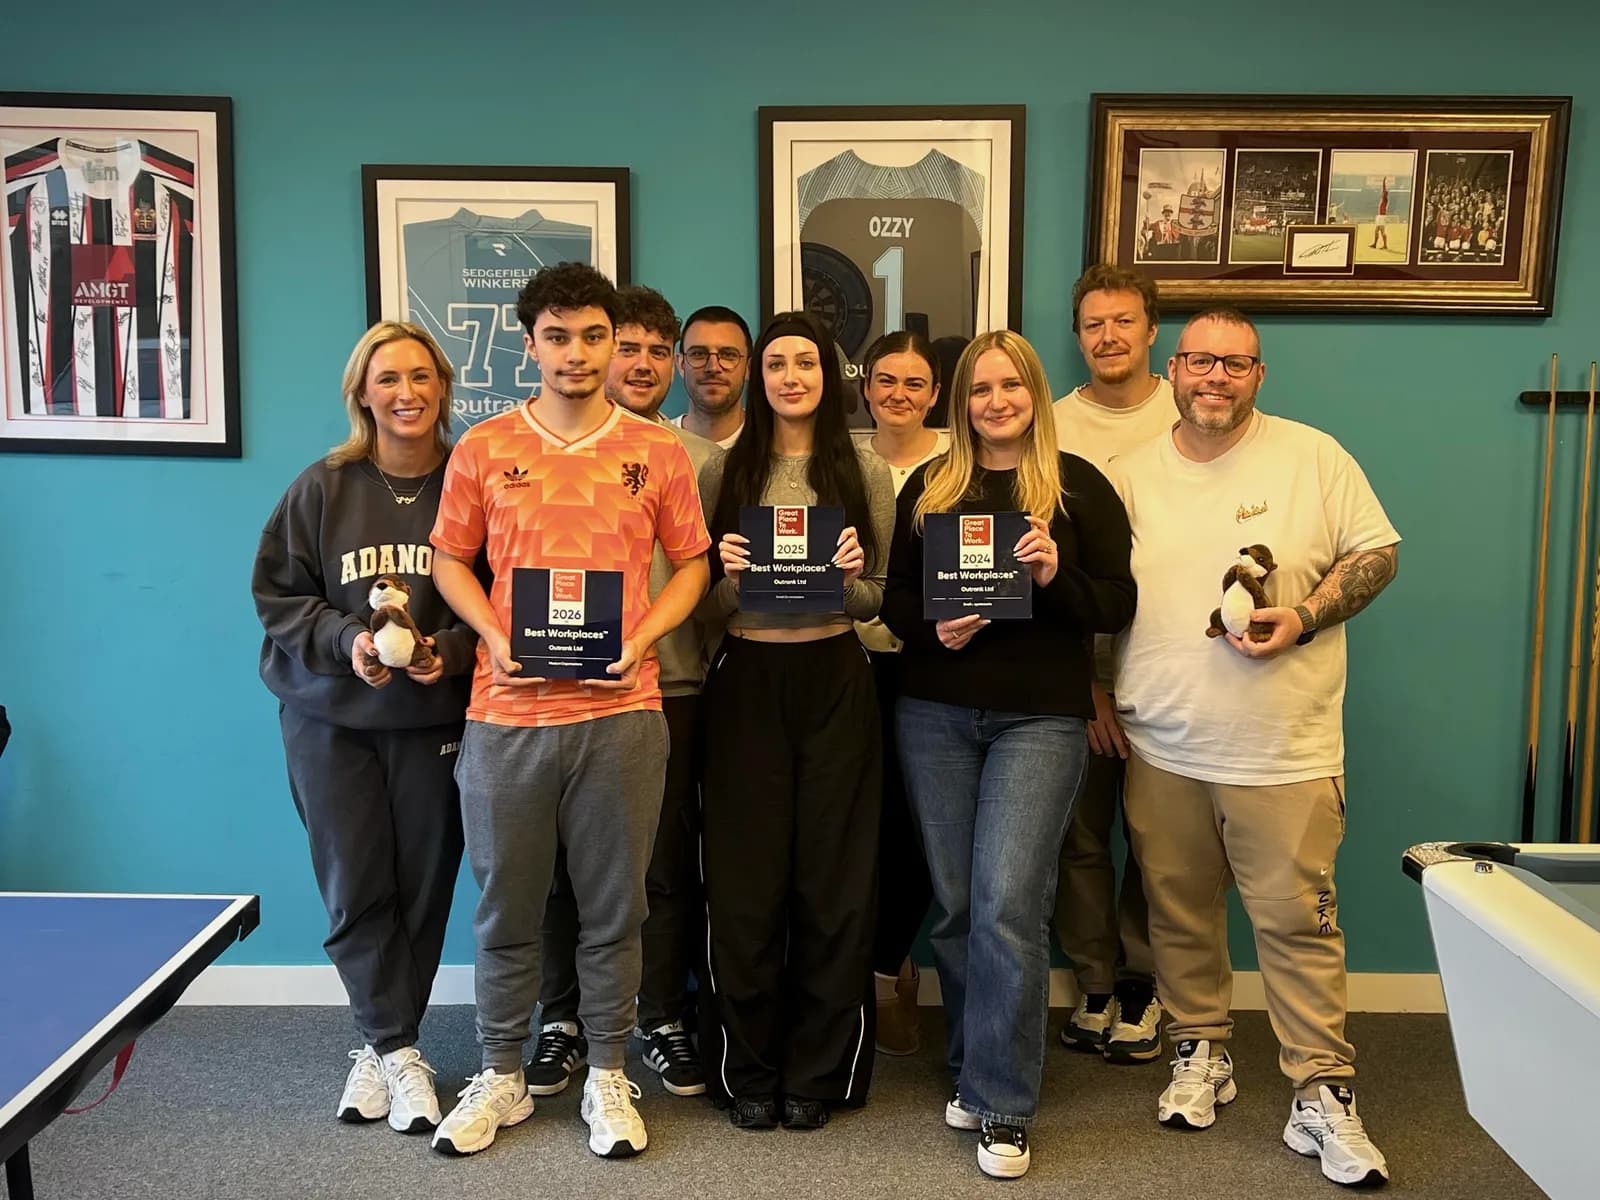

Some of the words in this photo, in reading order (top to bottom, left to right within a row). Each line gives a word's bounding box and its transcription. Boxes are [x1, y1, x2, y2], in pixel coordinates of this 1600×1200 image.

[869, 215, 914, 238] OZZY
[462, 268, 537, 278] SEDGEFIELD
[462, 277, 530, 289] WINKERS
[75, 281, 129, 298] AMGT
[873, 246, 904, 337] 1
[778, 509, 799, 517] Great
[963, 519, 985, 527] Great
[776, 544, 805, 554] 2025
[962, 553, 990, 564] 2024
[341, 544, 432, 585] ADANO
[751, 563, 771, 573] Best
[937, 571, 958, 580] Best
[552, 608, 582, 620] 2026
[524, 627, 546, 637] Best
[1316, 888, 1333, 935] NIKE
